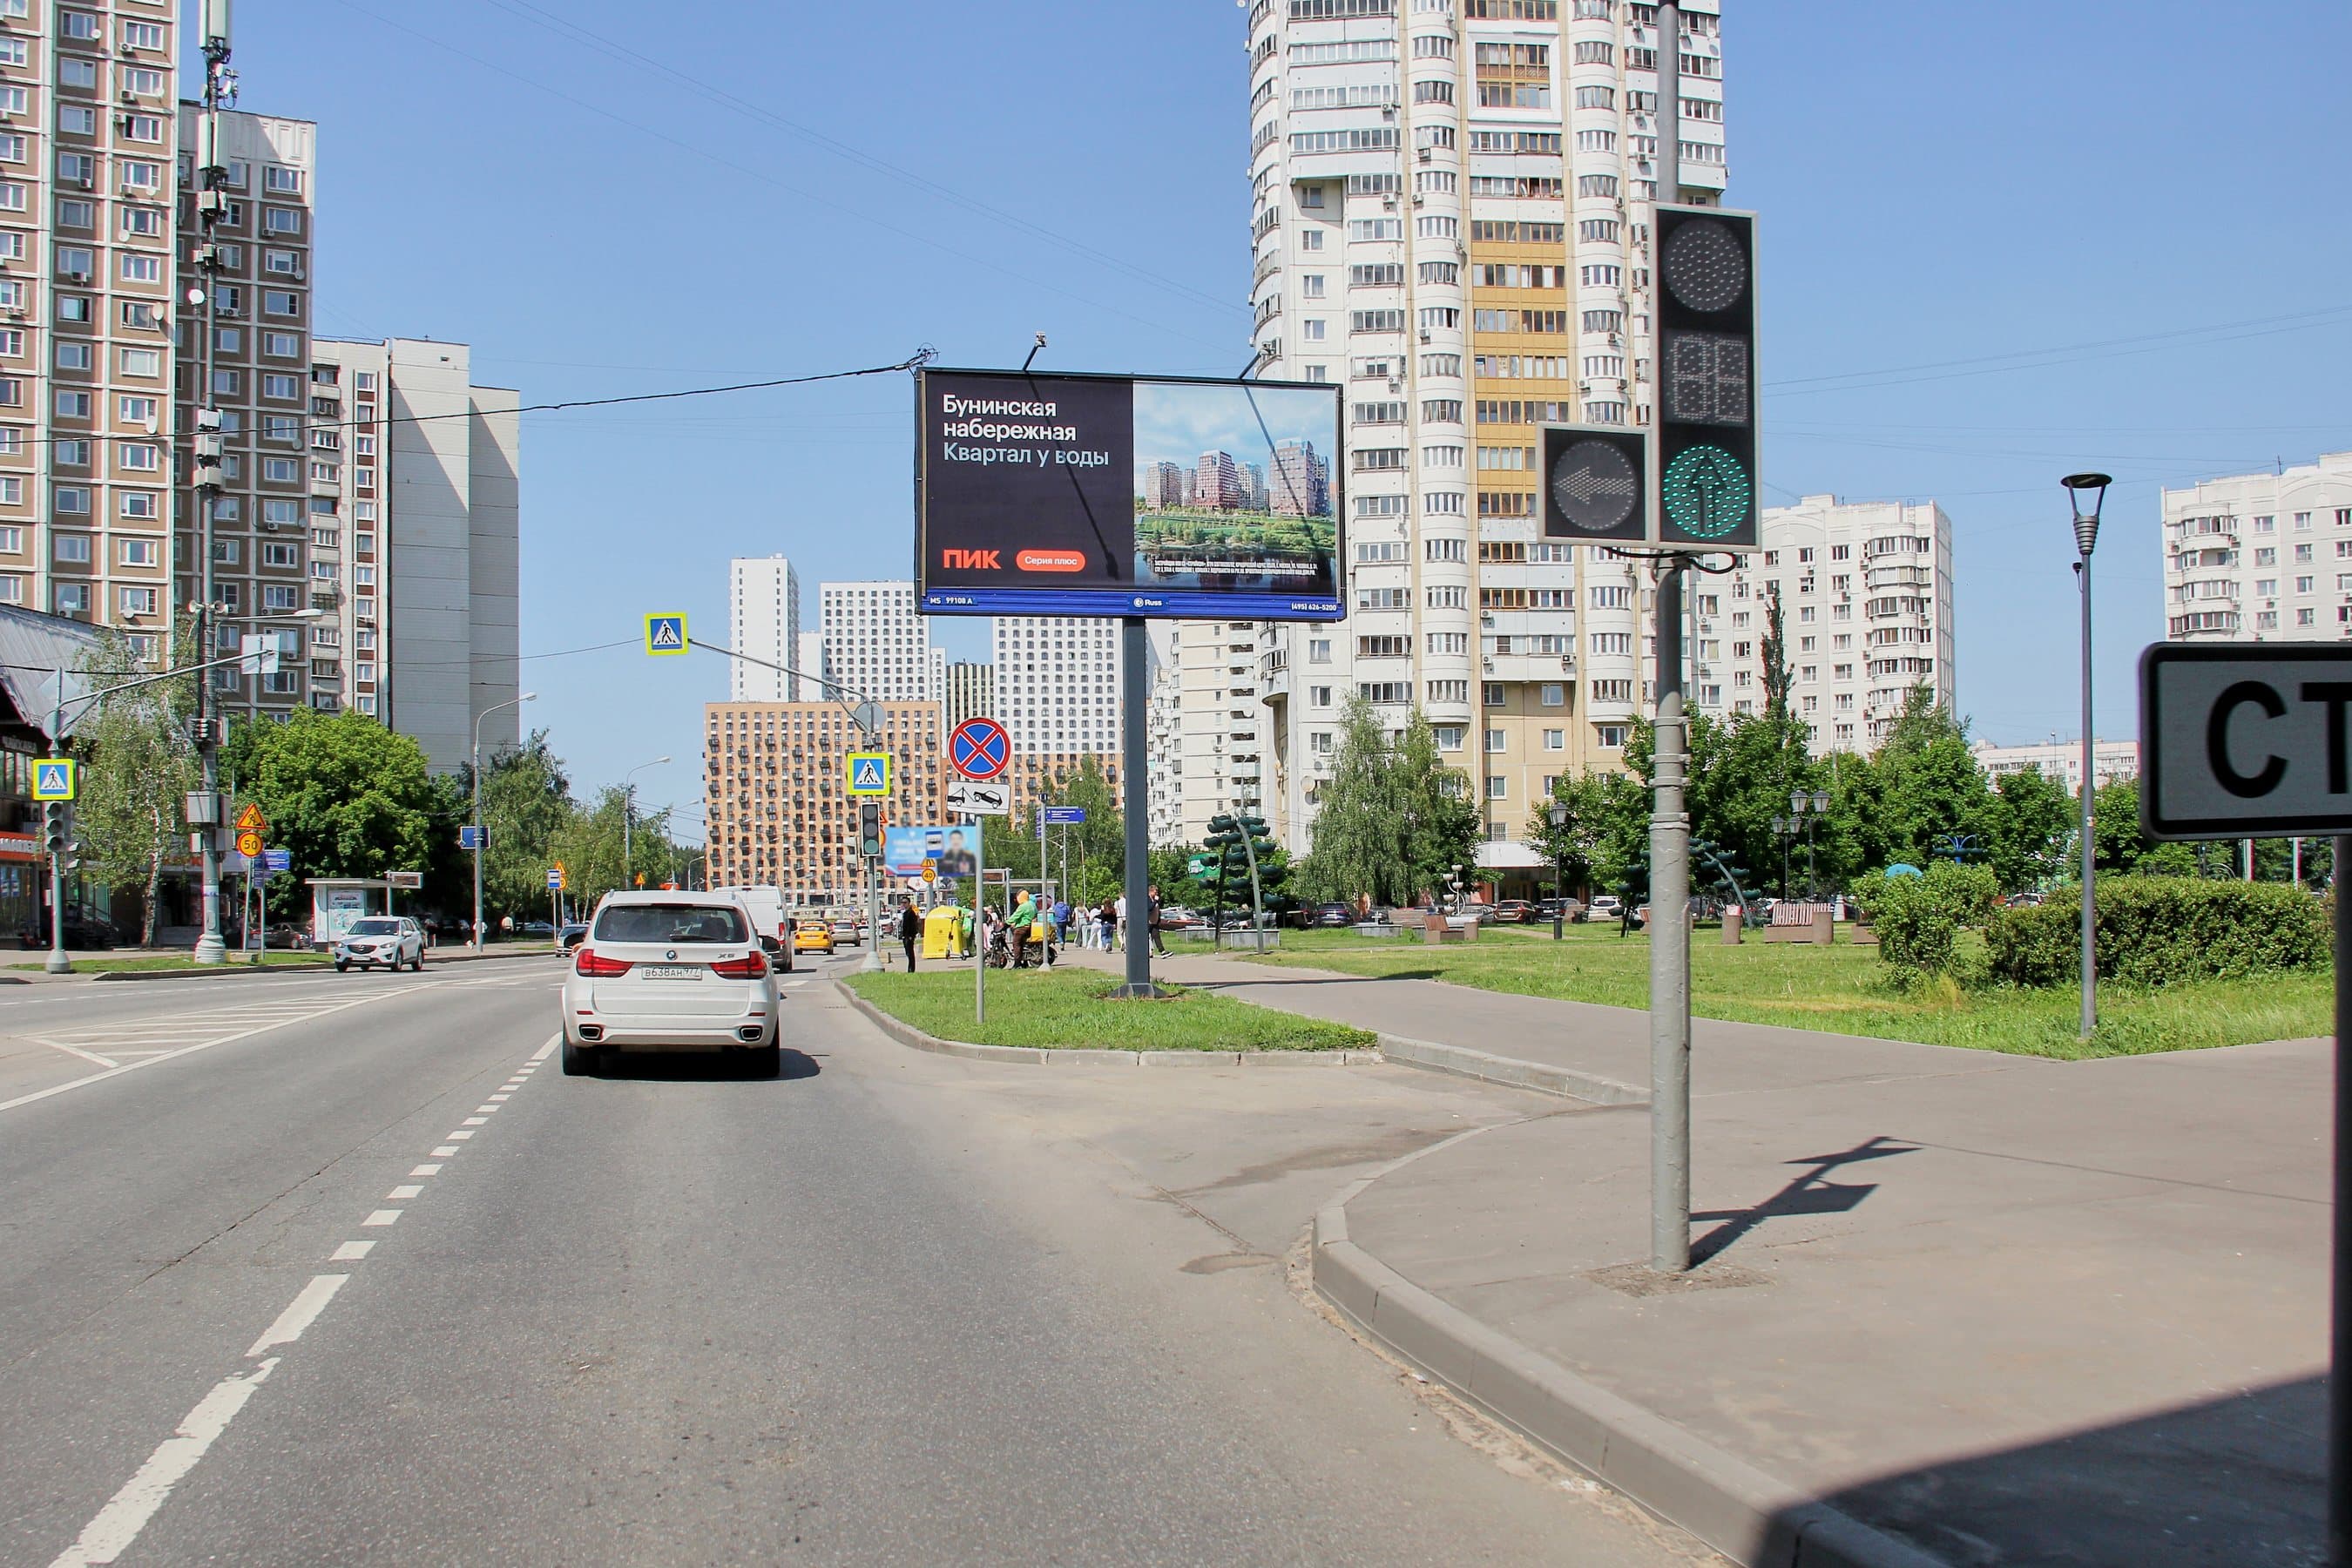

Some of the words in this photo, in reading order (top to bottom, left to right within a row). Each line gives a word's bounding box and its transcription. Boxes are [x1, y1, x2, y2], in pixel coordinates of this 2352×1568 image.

[943, 394, 1057, 417] Бунинская
[943, 418, 1077, 443] набережная
[943, 442, 1031, 466] Квартал
[1037, 449, 1050, 468] у
[1055, 449, 1109, 468] воды
[943, 549, 1002, 570] ПИК
[1024, 556, 1053, 566] Серия
[1291, 602, 1308, 611] (495)
[1308, 603, 1337, 612] 626-5200
[244, 840, 258, 850] 50
